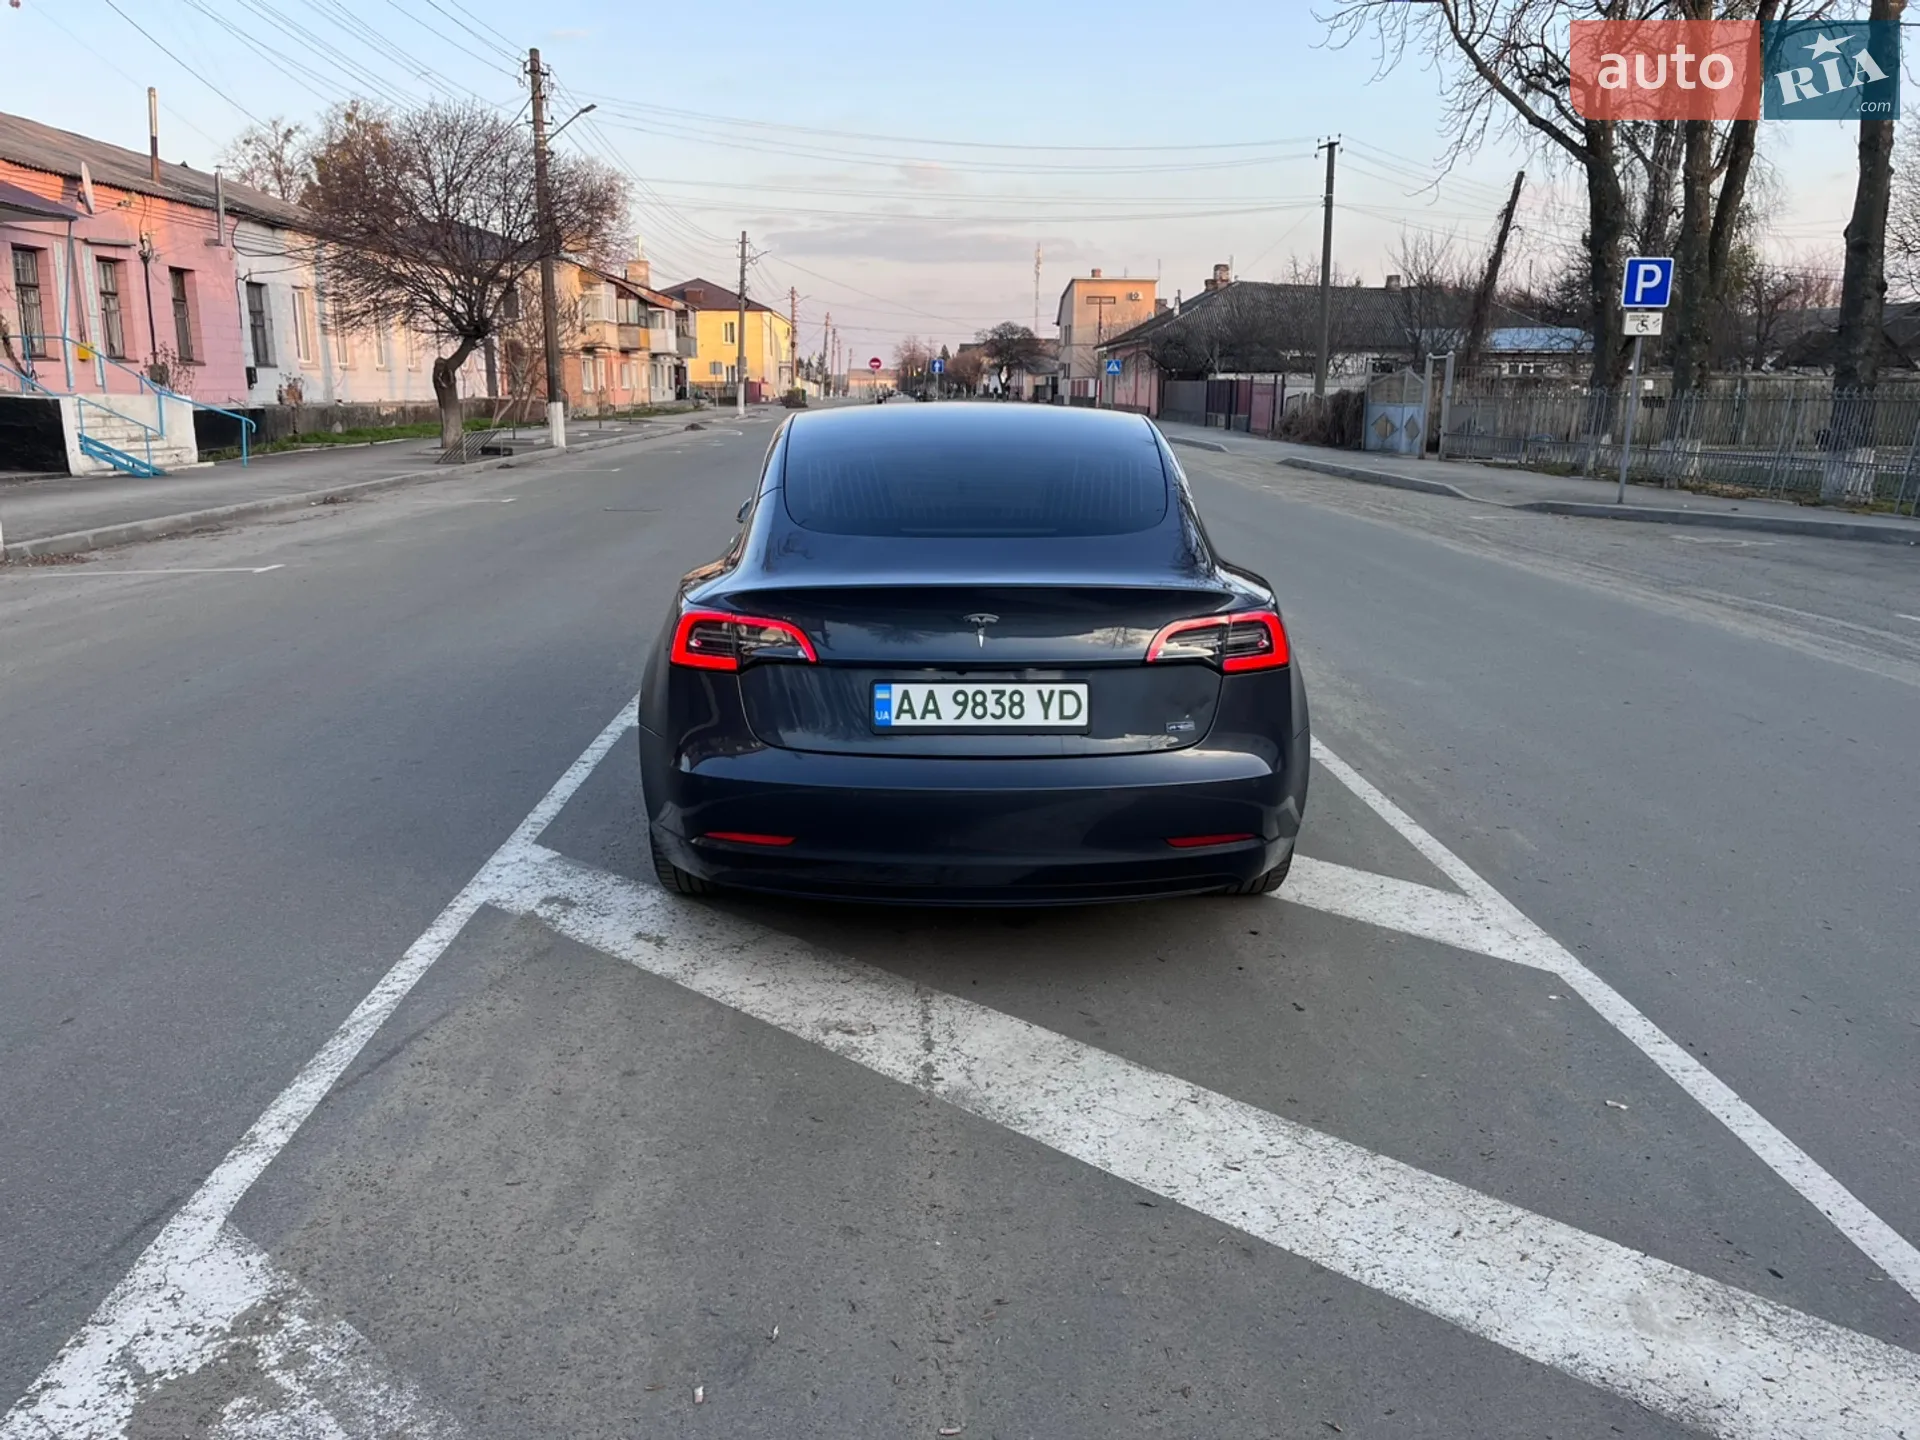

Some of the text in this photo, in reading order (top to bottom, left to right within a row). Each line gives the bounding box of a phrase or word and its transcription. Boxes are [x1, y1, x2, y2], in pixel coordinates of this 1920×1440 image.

[1634, 264, 1663, 303] P
[874, 710, 890, 720] UA
[894, 689, 1083, 720] AA 9838 YD
